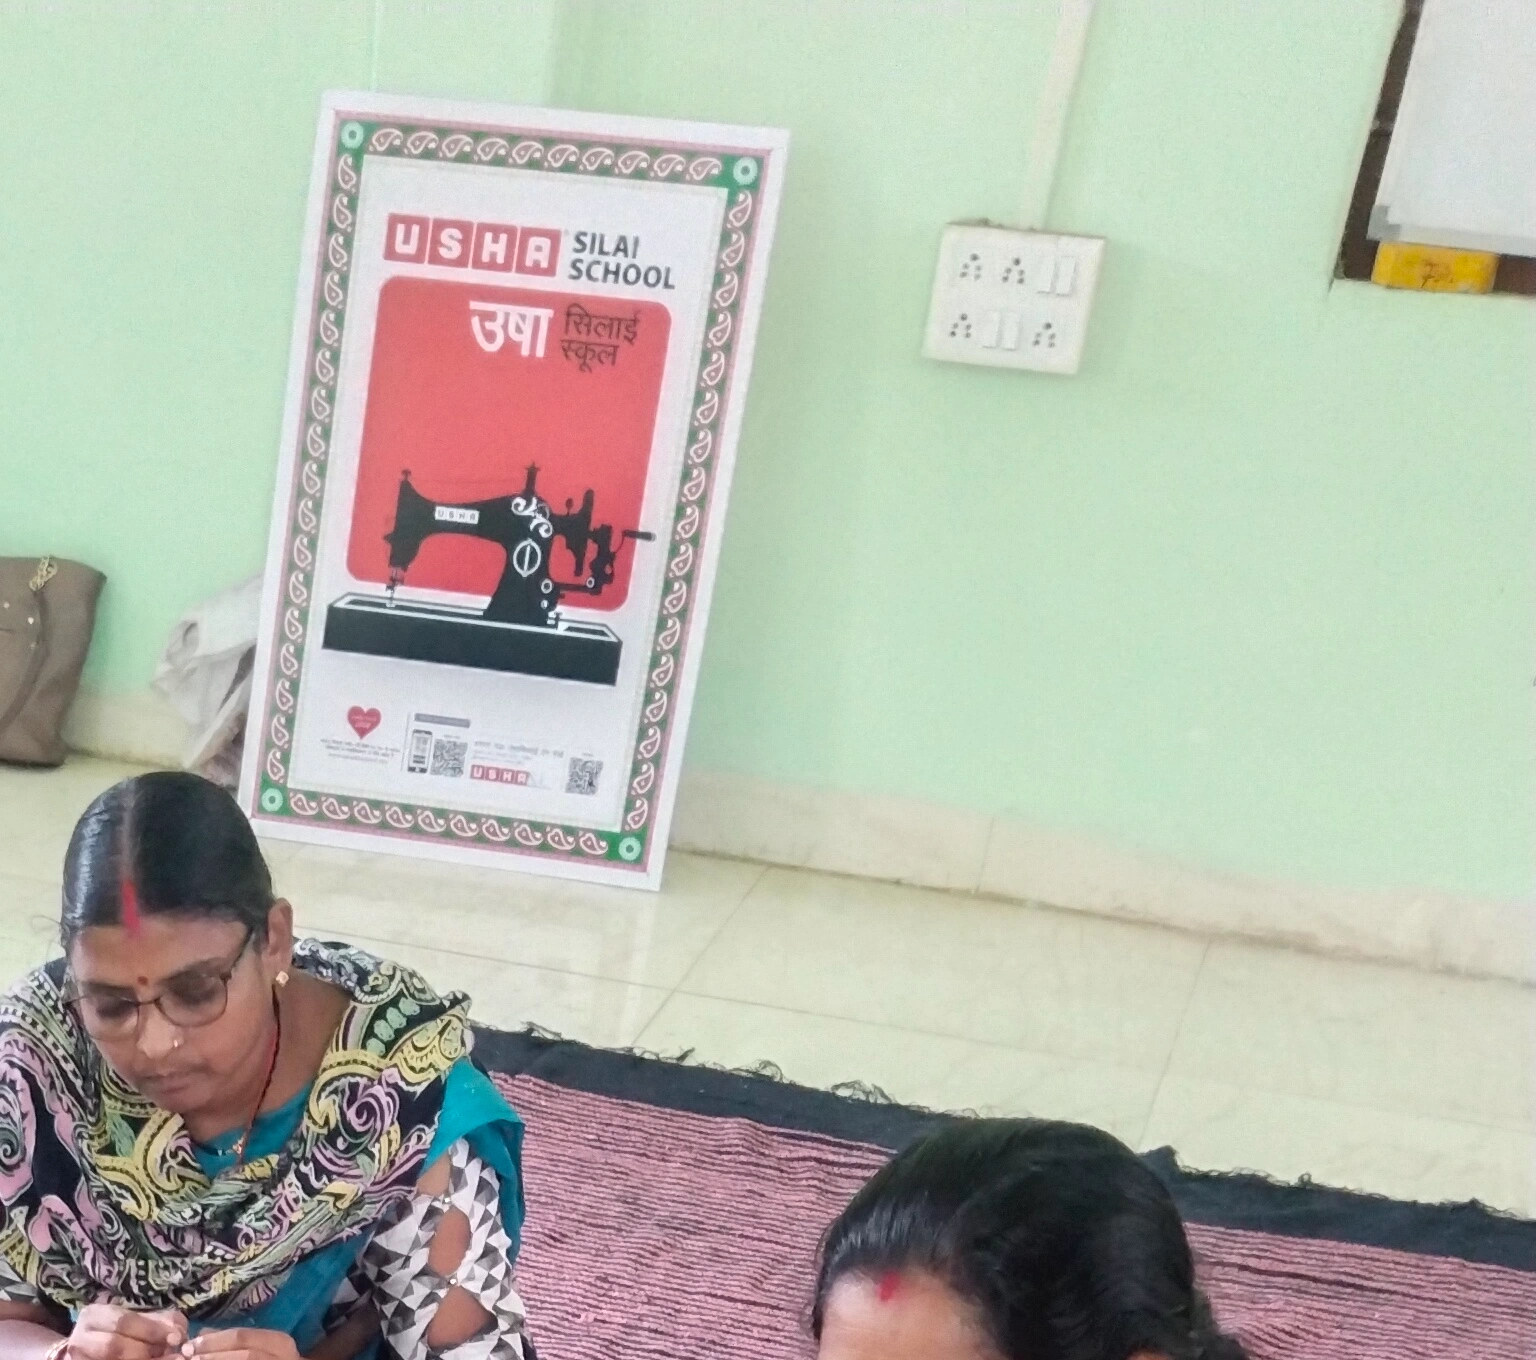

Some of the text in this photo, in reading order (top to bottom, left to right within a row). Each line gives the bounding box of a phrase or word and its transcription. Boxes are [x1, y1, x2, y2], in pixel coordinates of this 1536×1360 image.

[390, 221, 555, 271] USHA
[571, 230, 641, 260] SILAI
[567, 258, 677, 291] SCHOOL
[468, 300, 555, 359] उषा
[565, 302, 642, 346] सिलाई
[560, 338, 620, 374] स्कूल
[471, 764, 529, 785] USHA
